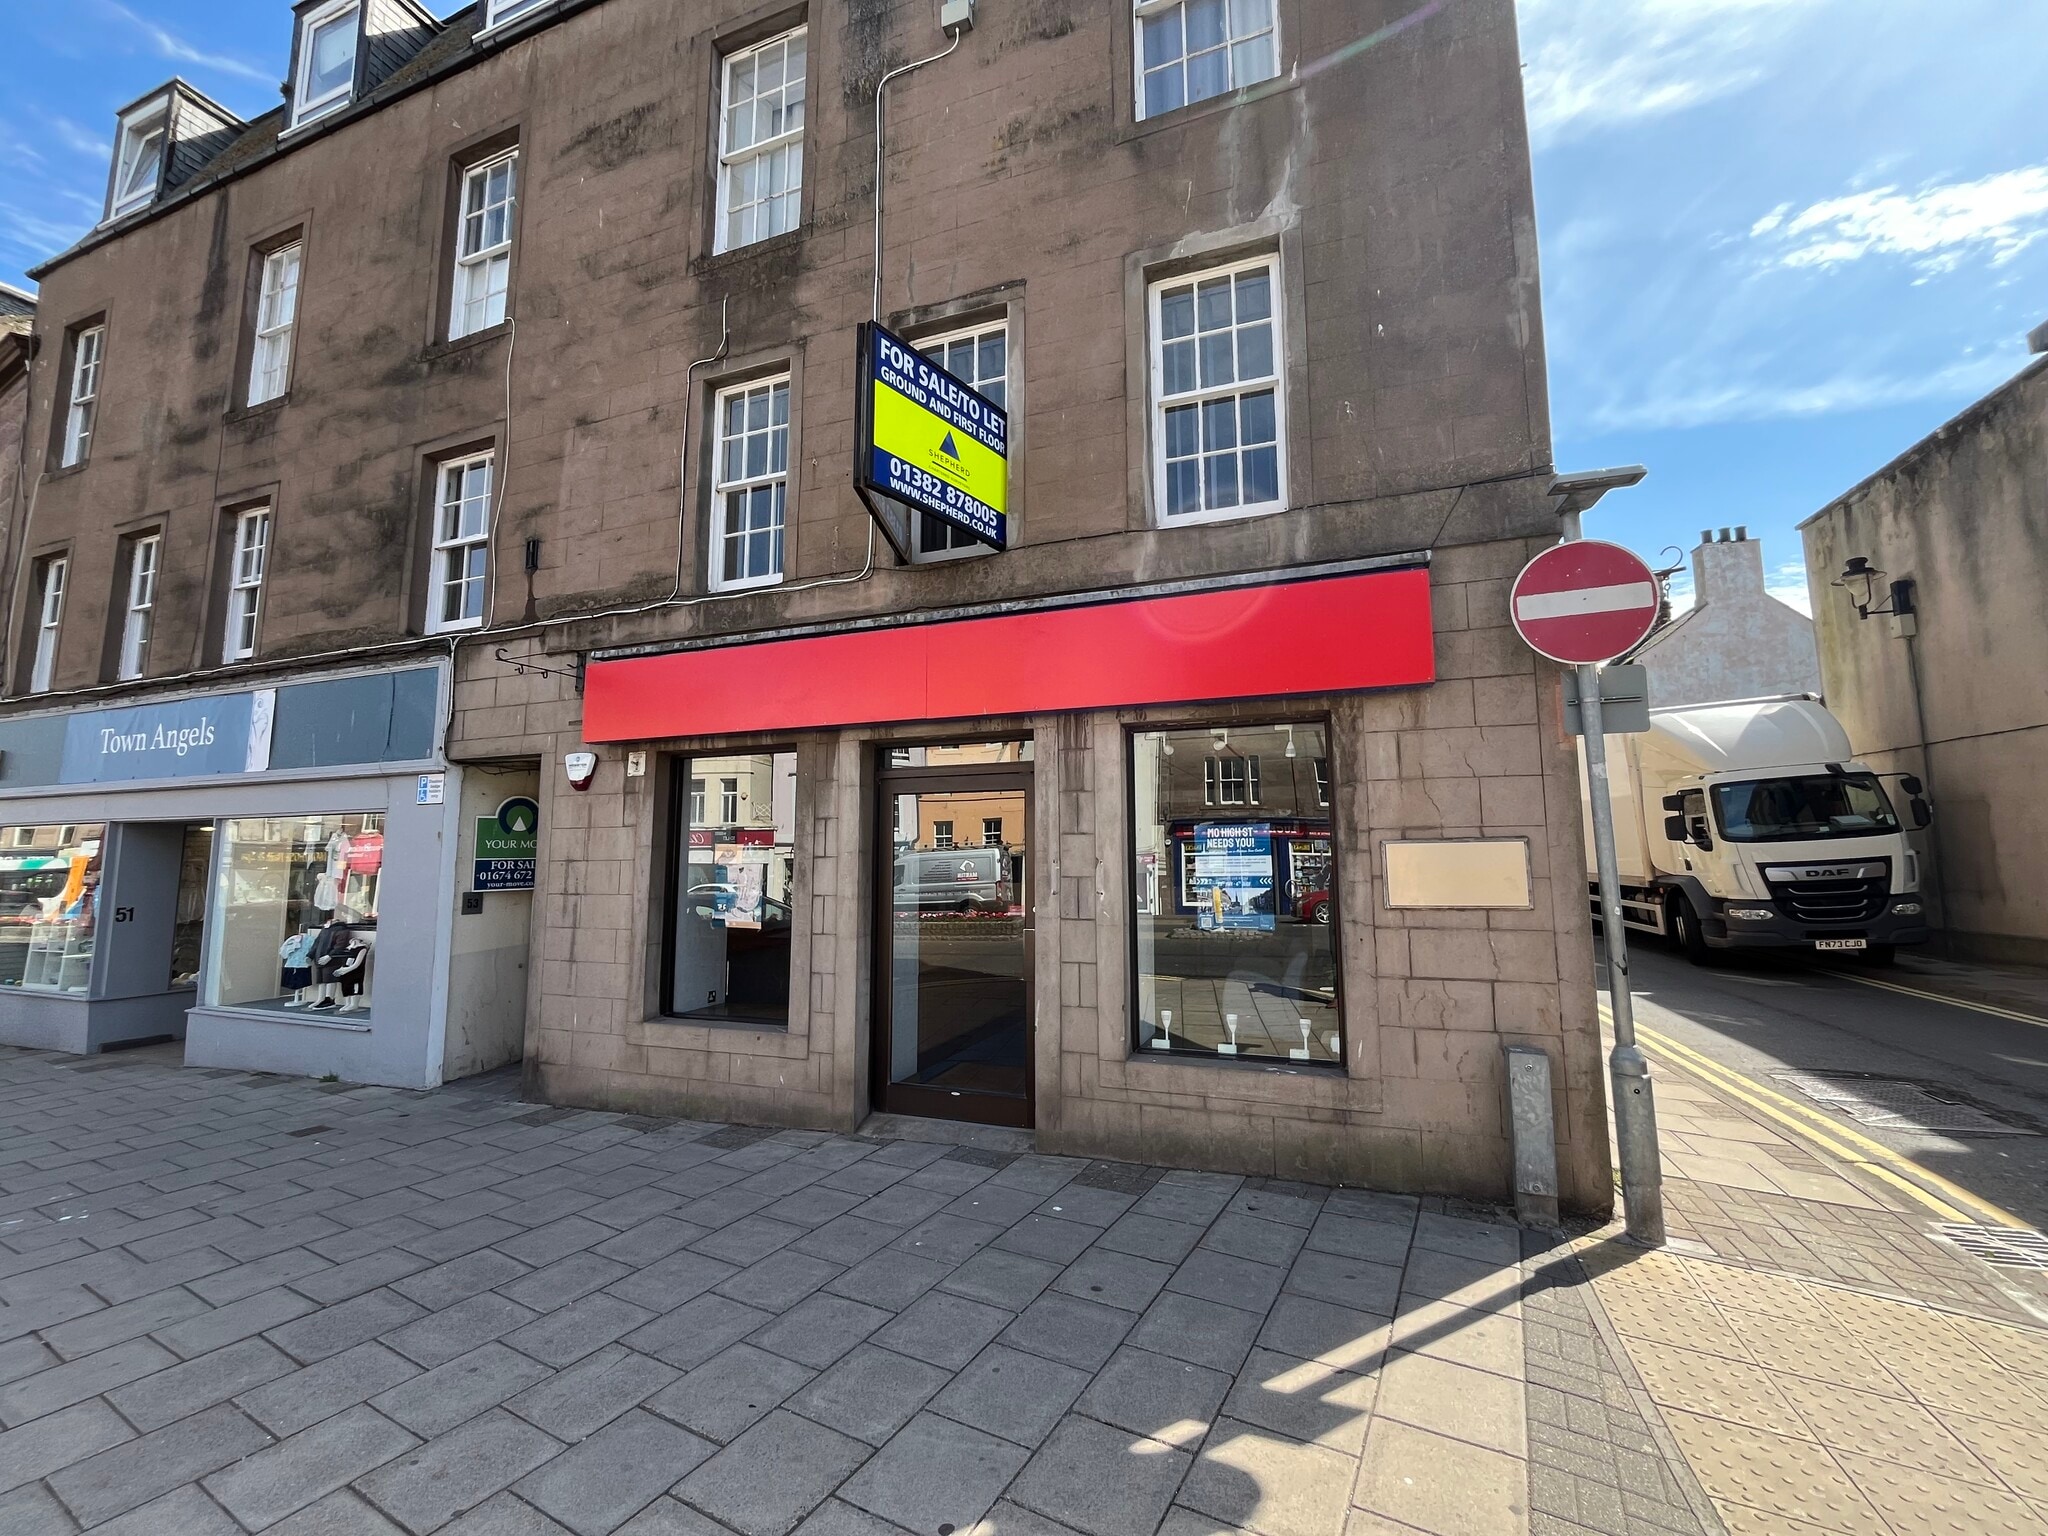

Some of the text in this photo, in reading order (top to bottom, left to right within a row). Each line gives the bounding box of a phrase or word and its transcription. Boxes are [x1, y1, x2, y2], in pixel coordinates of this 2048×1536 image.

[880, 337, 1006, 438] FOR SALE/TO LET
[880, 365, 1006, 455] GROUND AND FIRST FLOOR
[928, 448, 971, 477] SHEPHERD
[890, 457, 942, 498] 01382
[946, 485, 997, 527] 878005
[889, 476, 997, 540] WWW.SHEPHERD.CO.UK
[100, 716, 215, 756] Town Angels
[1206, 827, 1219, 838] MO
[1219, 827, 1242, 837] HIGH
[1242, 826, 1254, 837] ST
[485, 839, 517, 849] YOUR
[1206, 838, 1234, 848] NEEDS
[1234, 837, 1255, 847] YOU!
[491, 860, 515, 870] FOR
[479, 870, 532, 880] 01674 672
[1805, 868, 1849, 877] DAF
[467, 898, 479, 909] 53
[115, 906, 135, 923] 51
[1819, 940, 1843, 948] FN73
